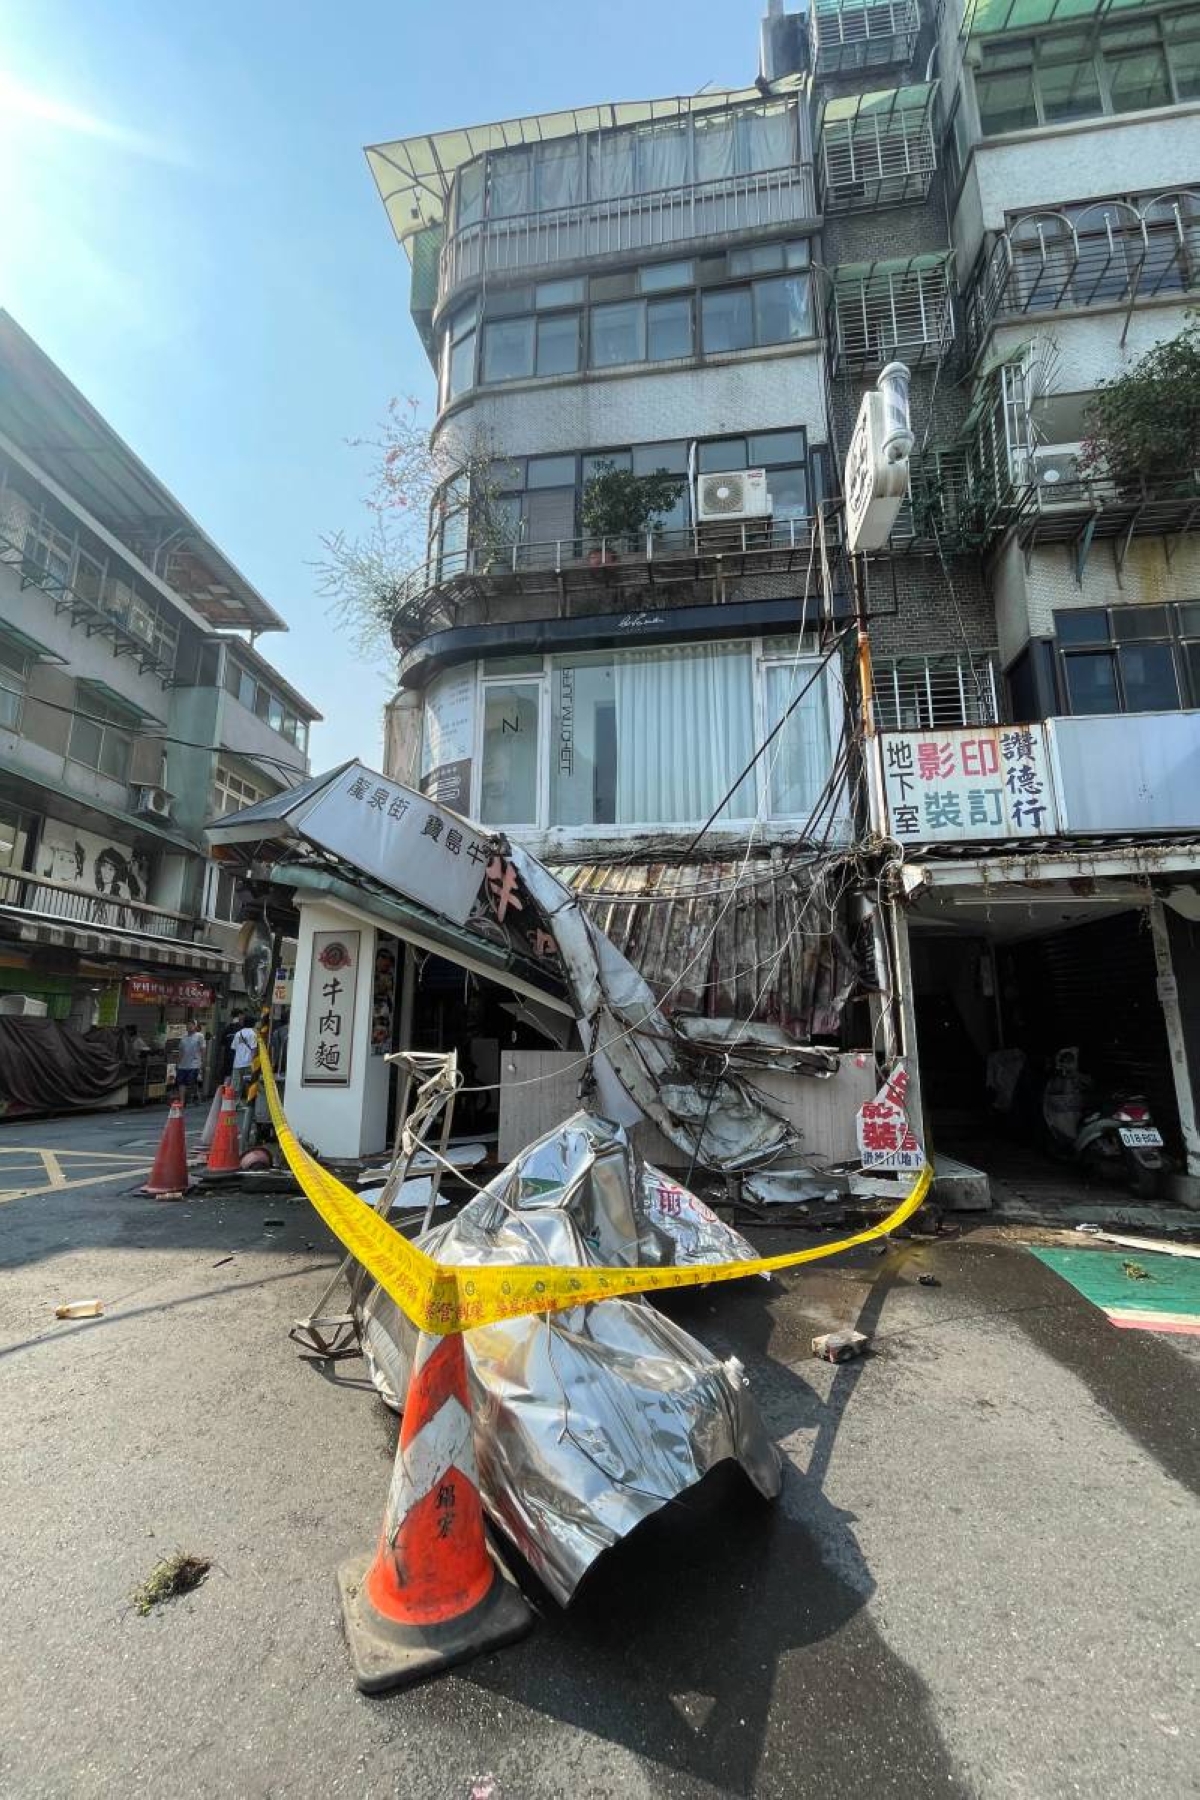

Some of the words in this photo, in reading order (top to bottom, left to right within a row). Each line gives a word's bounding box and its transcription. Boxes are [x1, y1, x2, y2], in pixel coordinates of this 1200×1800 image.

[886, 740, 921, 834] 地下室
[917, 739, 1000, 780] 影印
[1001, 731, 1047, 829] 讚德行
[346, 776, 410, 821] 龍泉街
[924, 788, 1003, 829] 裝訂
[314, 976, 344, 1072] 牛肉麵
